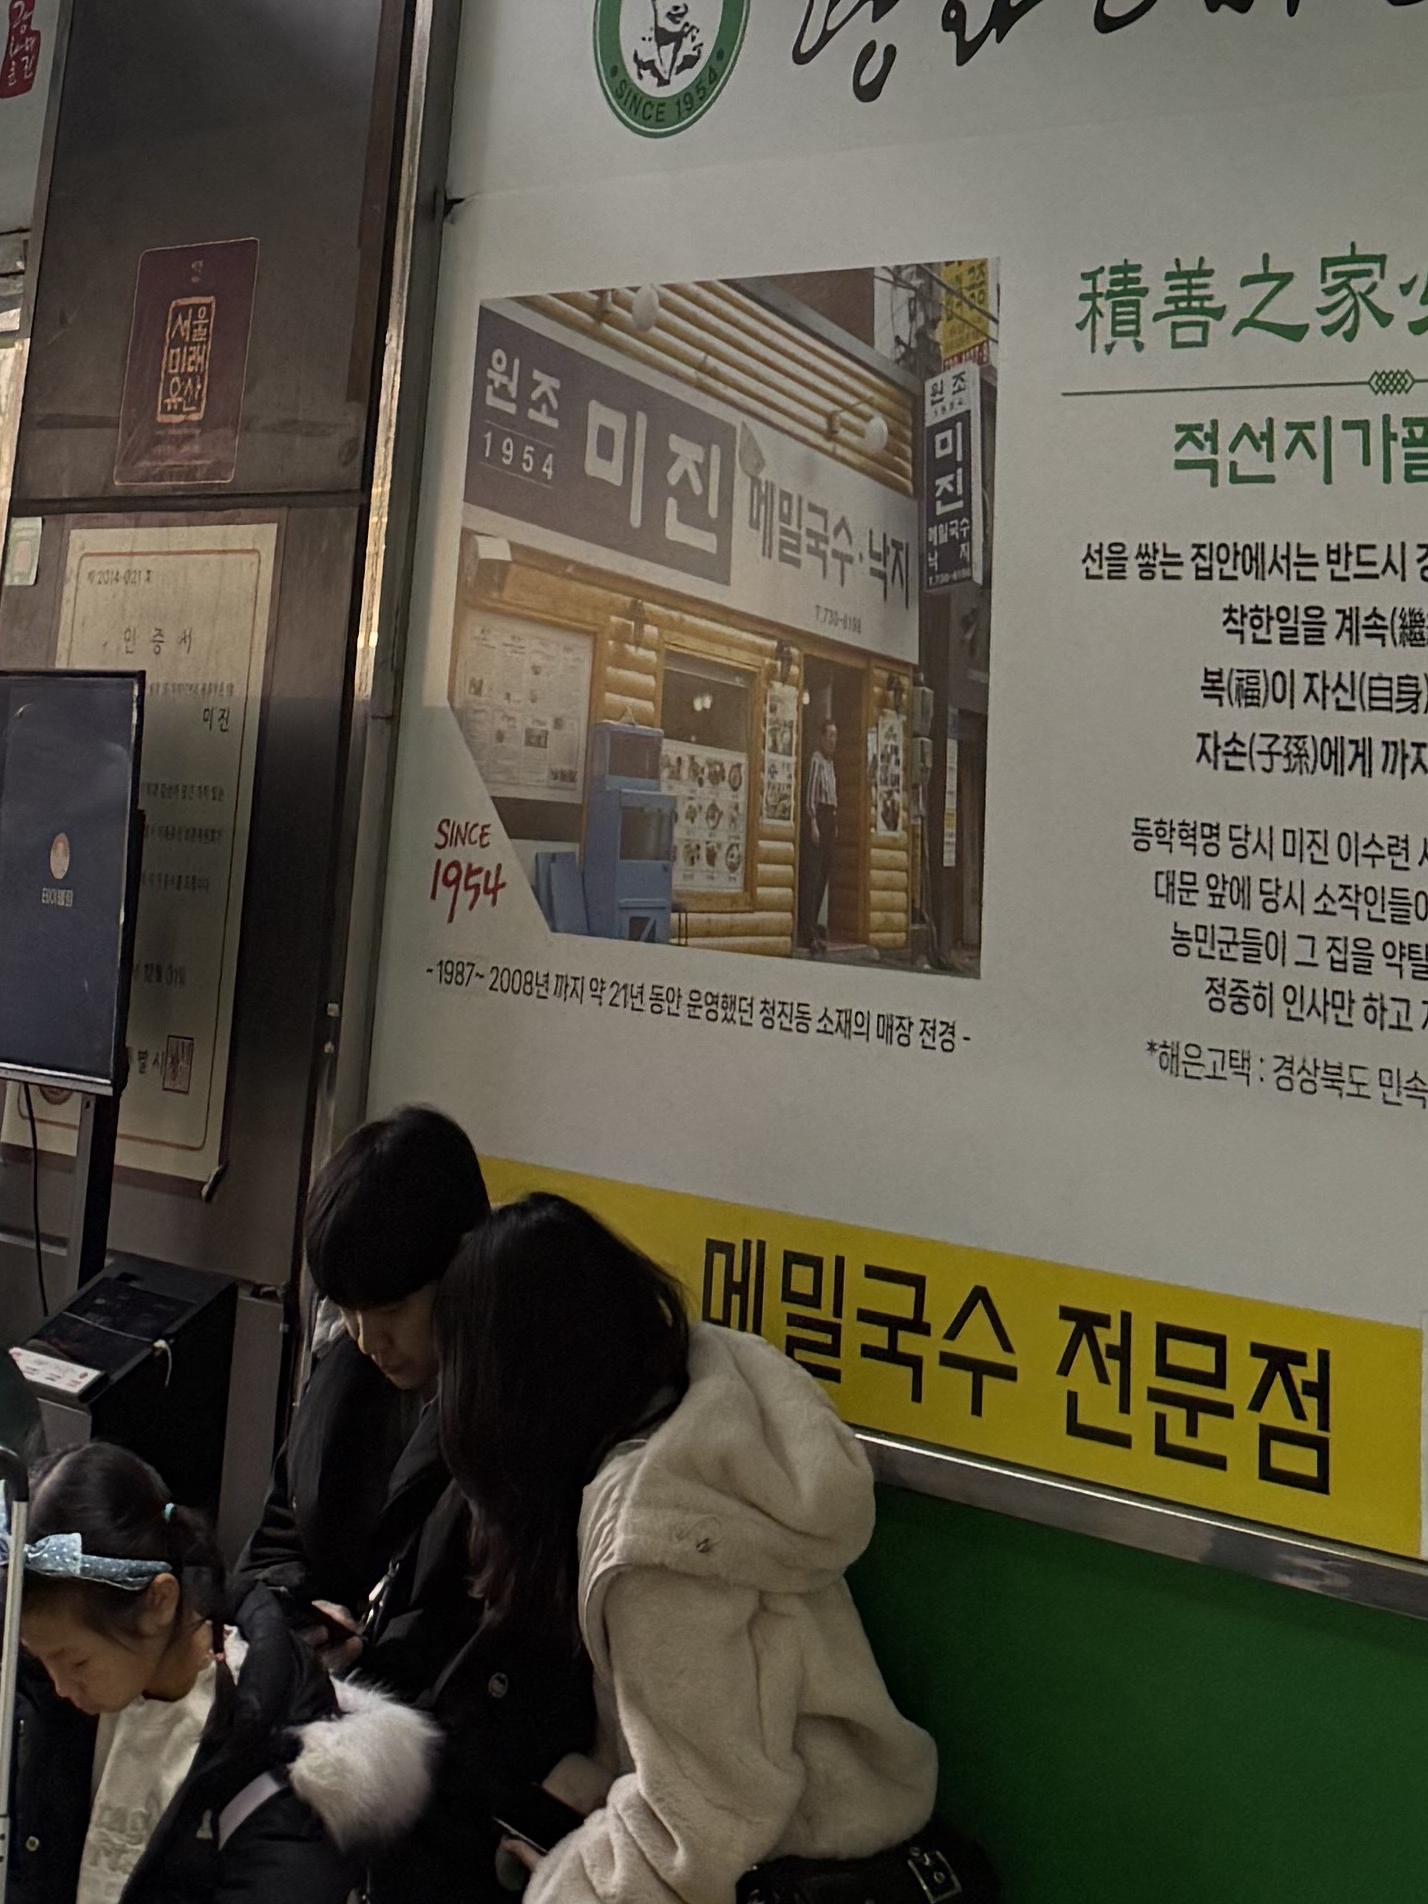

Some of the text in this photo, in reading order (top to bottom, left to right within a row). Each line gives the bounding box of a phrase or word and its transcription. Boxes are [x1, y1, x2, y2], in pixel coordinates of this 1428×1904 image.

[615, 64, 719, 123] SINCE 1954
[170, 305, 210, 343] 서울
[167, 343, 206, 374] 미래
[163, 375, 203, 413] 유산
[484, 431, 555, 480] 1954
[485, 348, 561, 428] 원조
[584, 399, 721, 554] 미진
[935, 421, 964, 516] 미진
[1081, 541, 1128, 582] 선을
[1135, 542, 1184, 582] 쌓는
[1191, 541, 1319, 582] 집안에서는
[1327, 541, 1407, 583] 반드시
[1222, 604, 1327, 646] 착한일을
[1200, 666, 1295, 710] 복(福)이
[202, 705, 230, 733] 미진
[1196, 730, 1373, 779] 자손(子孫)에게
[434, 818, 492, 850] SINCE
[1131, 816, 1222, 859] 동학혁명
[1228, 821, 1275, 864] 당시
[1281, 825, 1330, 868] 미진
[1337, 828, 1411, 875] 이수련
[430, 859, 506, 923] 1954
[1154, 868, 1200, 909] 대문
[1205, 872, 1252, 912] 앞에
[1258, 875, 1306, 918] 당시
[1170, 921, 1287, 969] 농민군들이
[1294, 932, 1318, 970] 그
[1325, 936, 1375, 977] 집을
[489, 965, 549, 1000] 2008년
[553, 974, 585, 1005] 까지
[589, 976, 607, 1007] 약
[609, 980, 645, 1013] 21년
[649, 983, 683, 1018] 동안
[687, 989, 754, 1027] 운영했던
[759, 998, 812, 1034] 청진동
[816, 1006, 871, 1042] 소재의
[876, 1012, 914, 1048] 매장
[919, 1017, 957, 1053] 전경
[1204, 977, 1275, 1019] 정중히
[1281, 983, 1356, 1028] 인사만
[1362, 991, 1415, 1034] 하고
[1272, 1051, 1372, 1103] 경상북도
[700, 1237, 1332, 1495] 메밀국수 전문점
